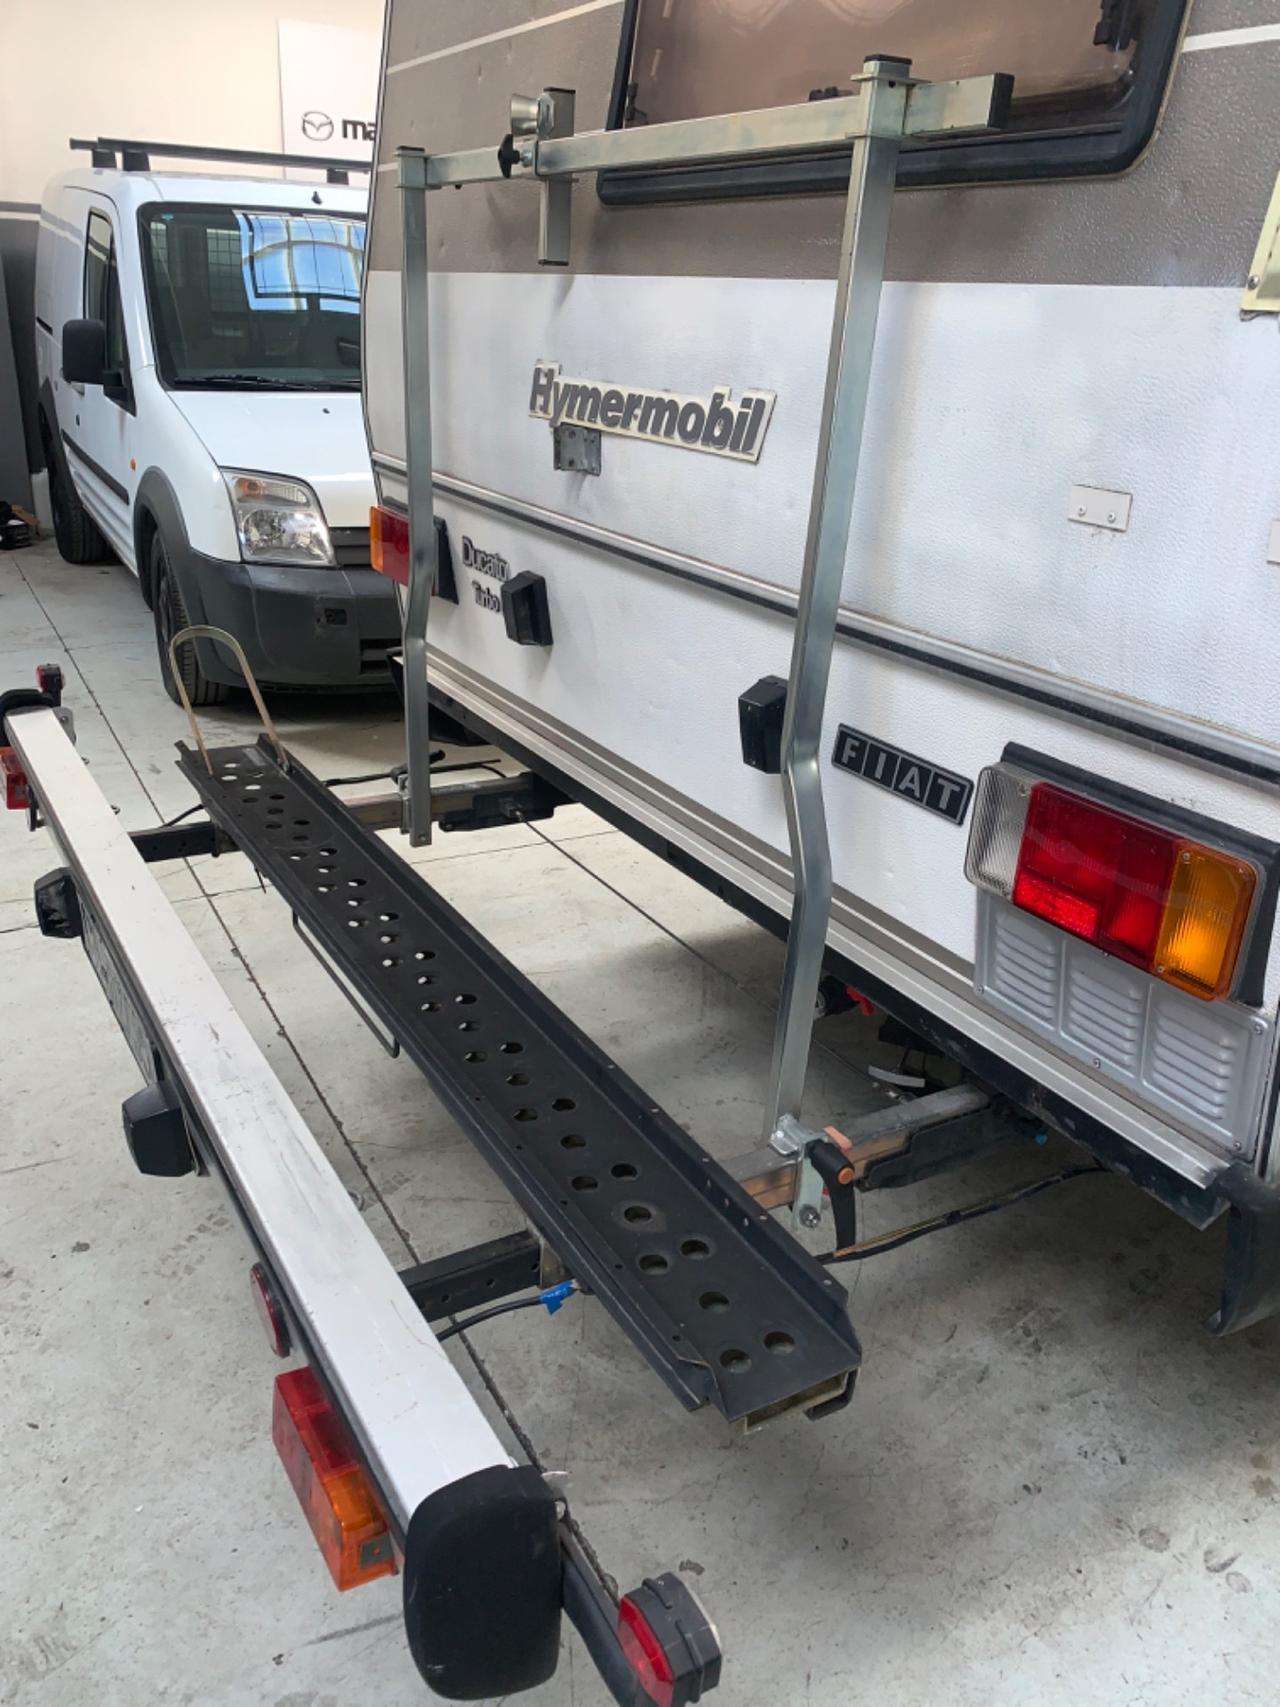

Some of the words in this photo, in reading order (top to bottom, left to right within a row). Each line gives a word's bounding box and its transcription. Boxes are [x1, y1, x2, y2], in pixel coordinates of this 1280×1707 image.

[530, 366, 767, 453] Hymermobil
[462, 535, 511, 582] Ducato
[841, 737, 961, 811] FIAT
